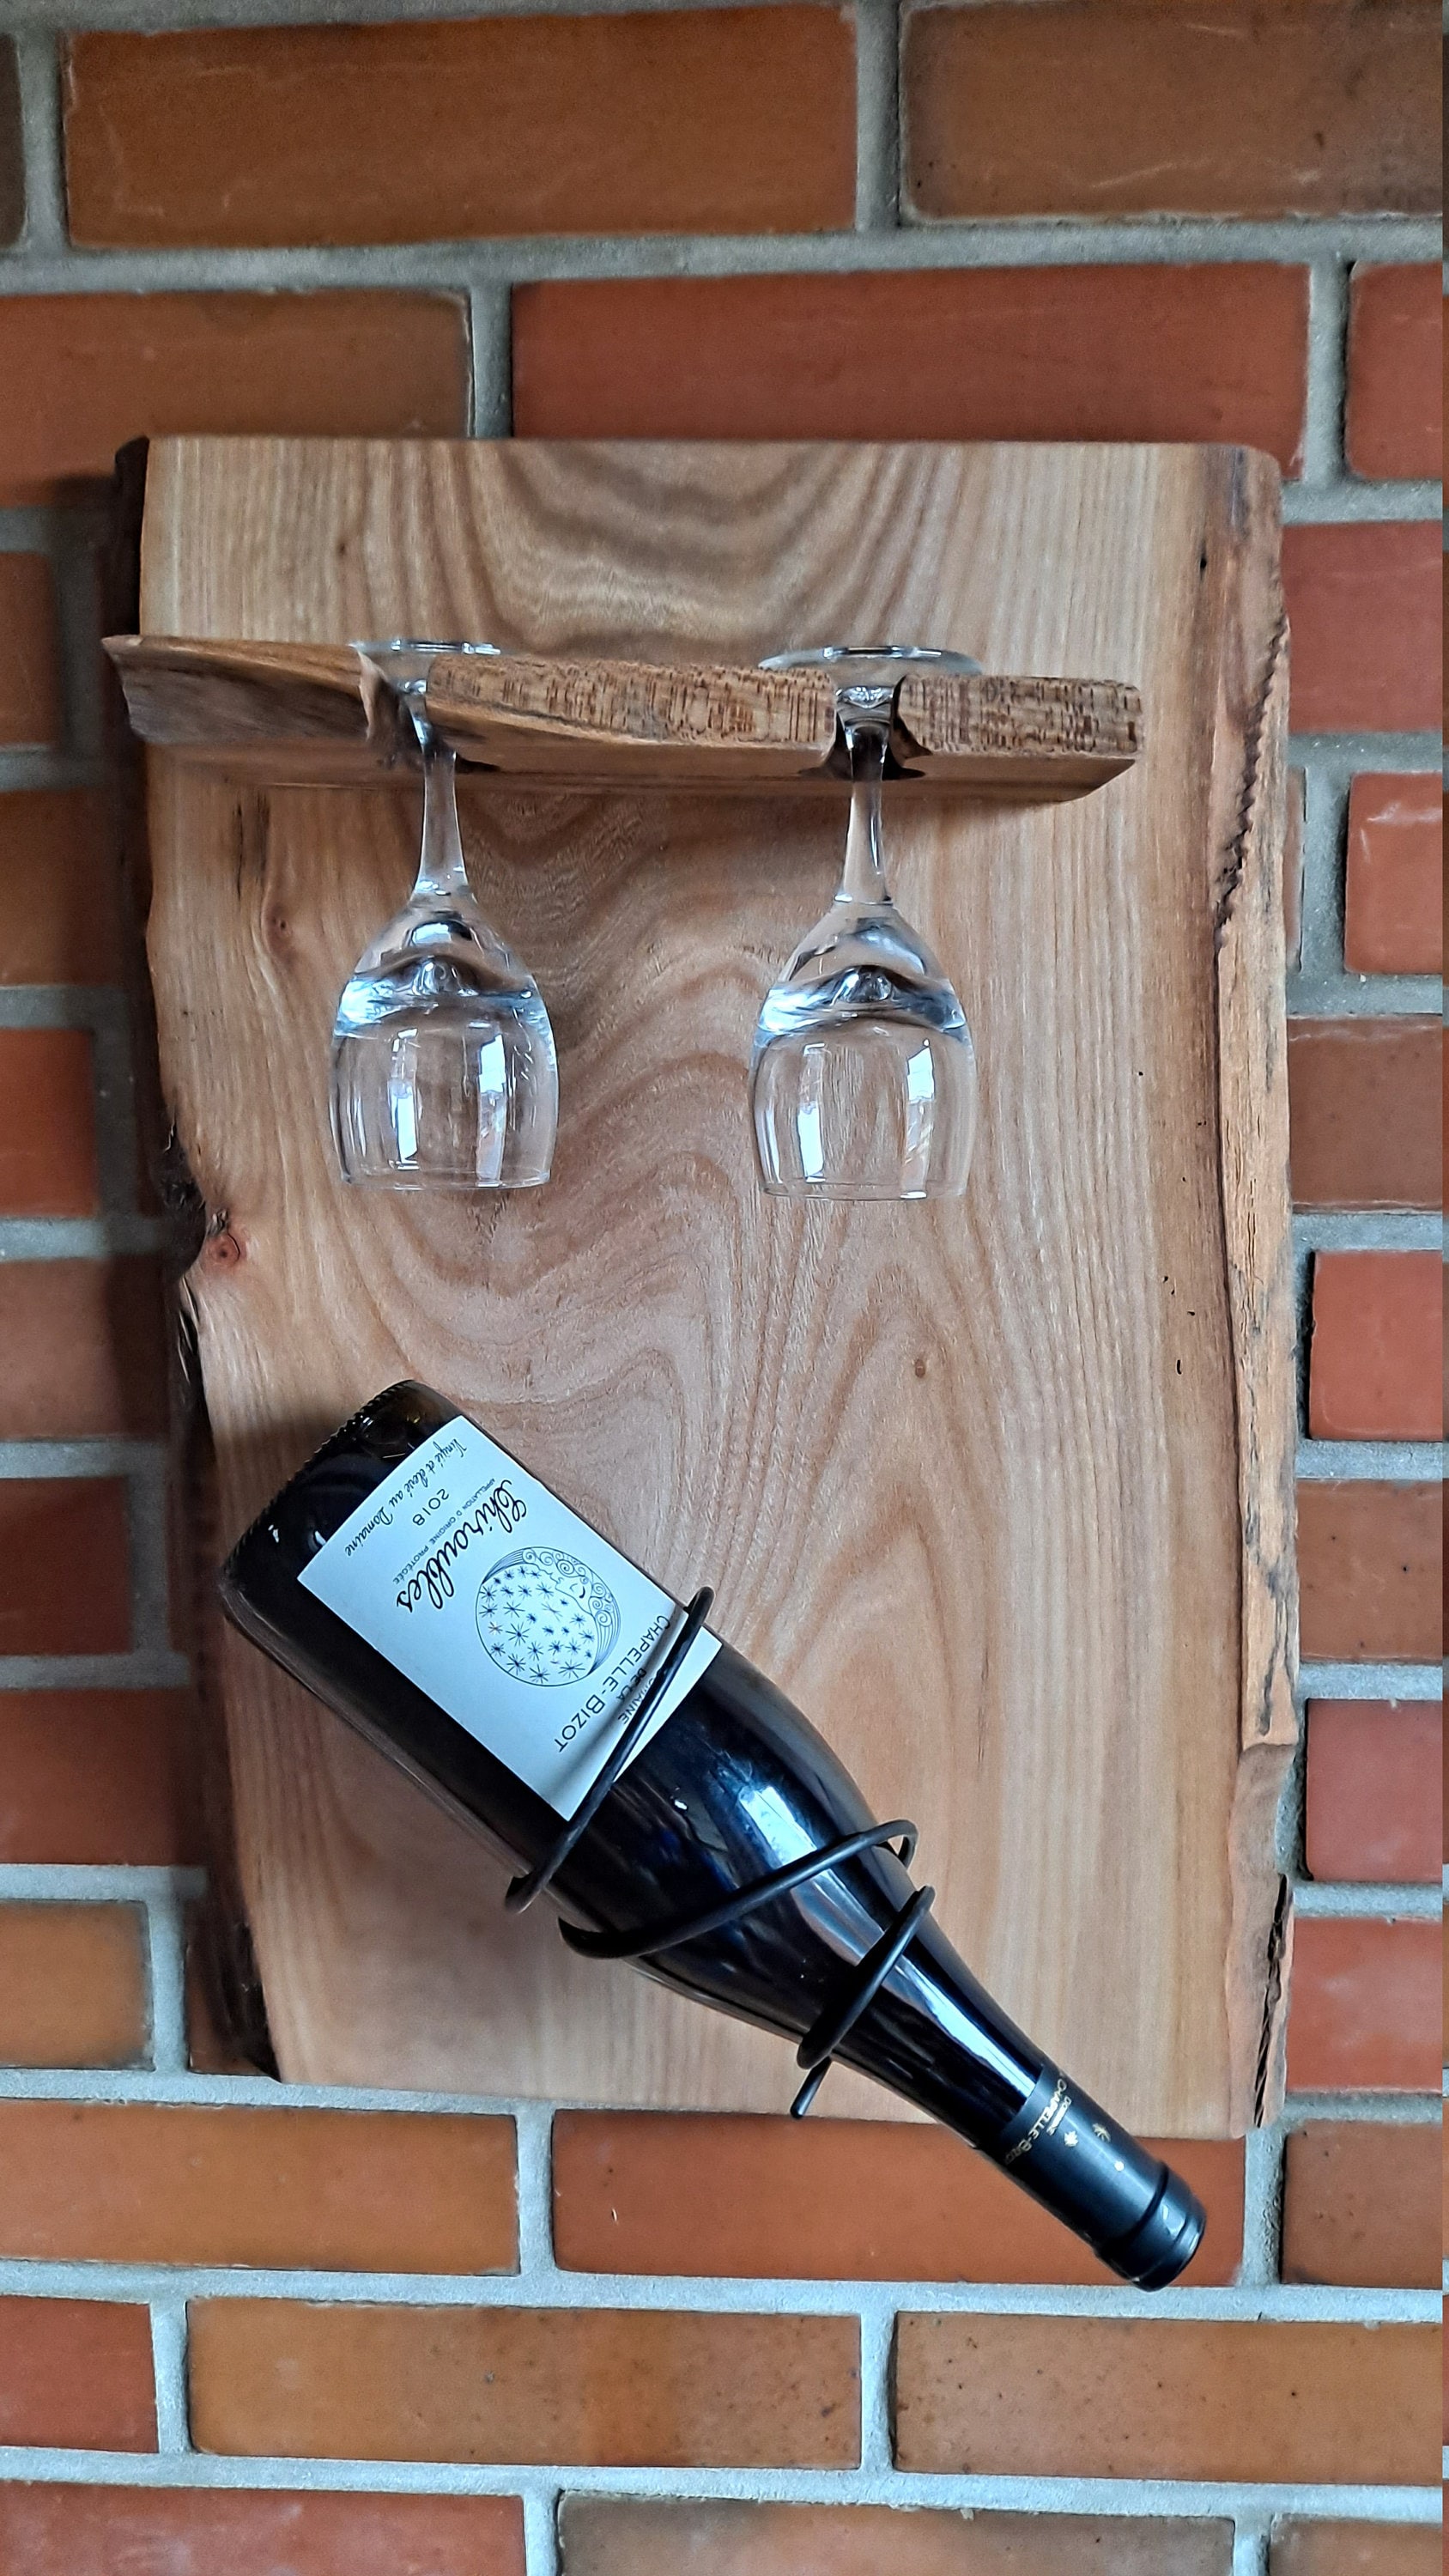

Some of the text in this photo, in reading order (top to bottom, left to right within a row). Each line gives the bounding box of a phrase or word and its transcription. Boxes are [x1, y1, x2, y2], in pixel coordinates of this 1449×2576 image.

[426, 1460, 436, 1474] et
[388, 1490, 404, 1508] au
[412, 1488, 450, 1526] 2018
[462, 1478, 496, 1510] APPELLATION
[344, 1506, 394, 1556] Domaine
[396, 1479, 527, 1613] Chiroubles
[392, 1545, 430, 1585] PROTÉGÉE
[615, 1668, 647, 1701] DE LA
[617, 1674, 658, 1725] MAINE
